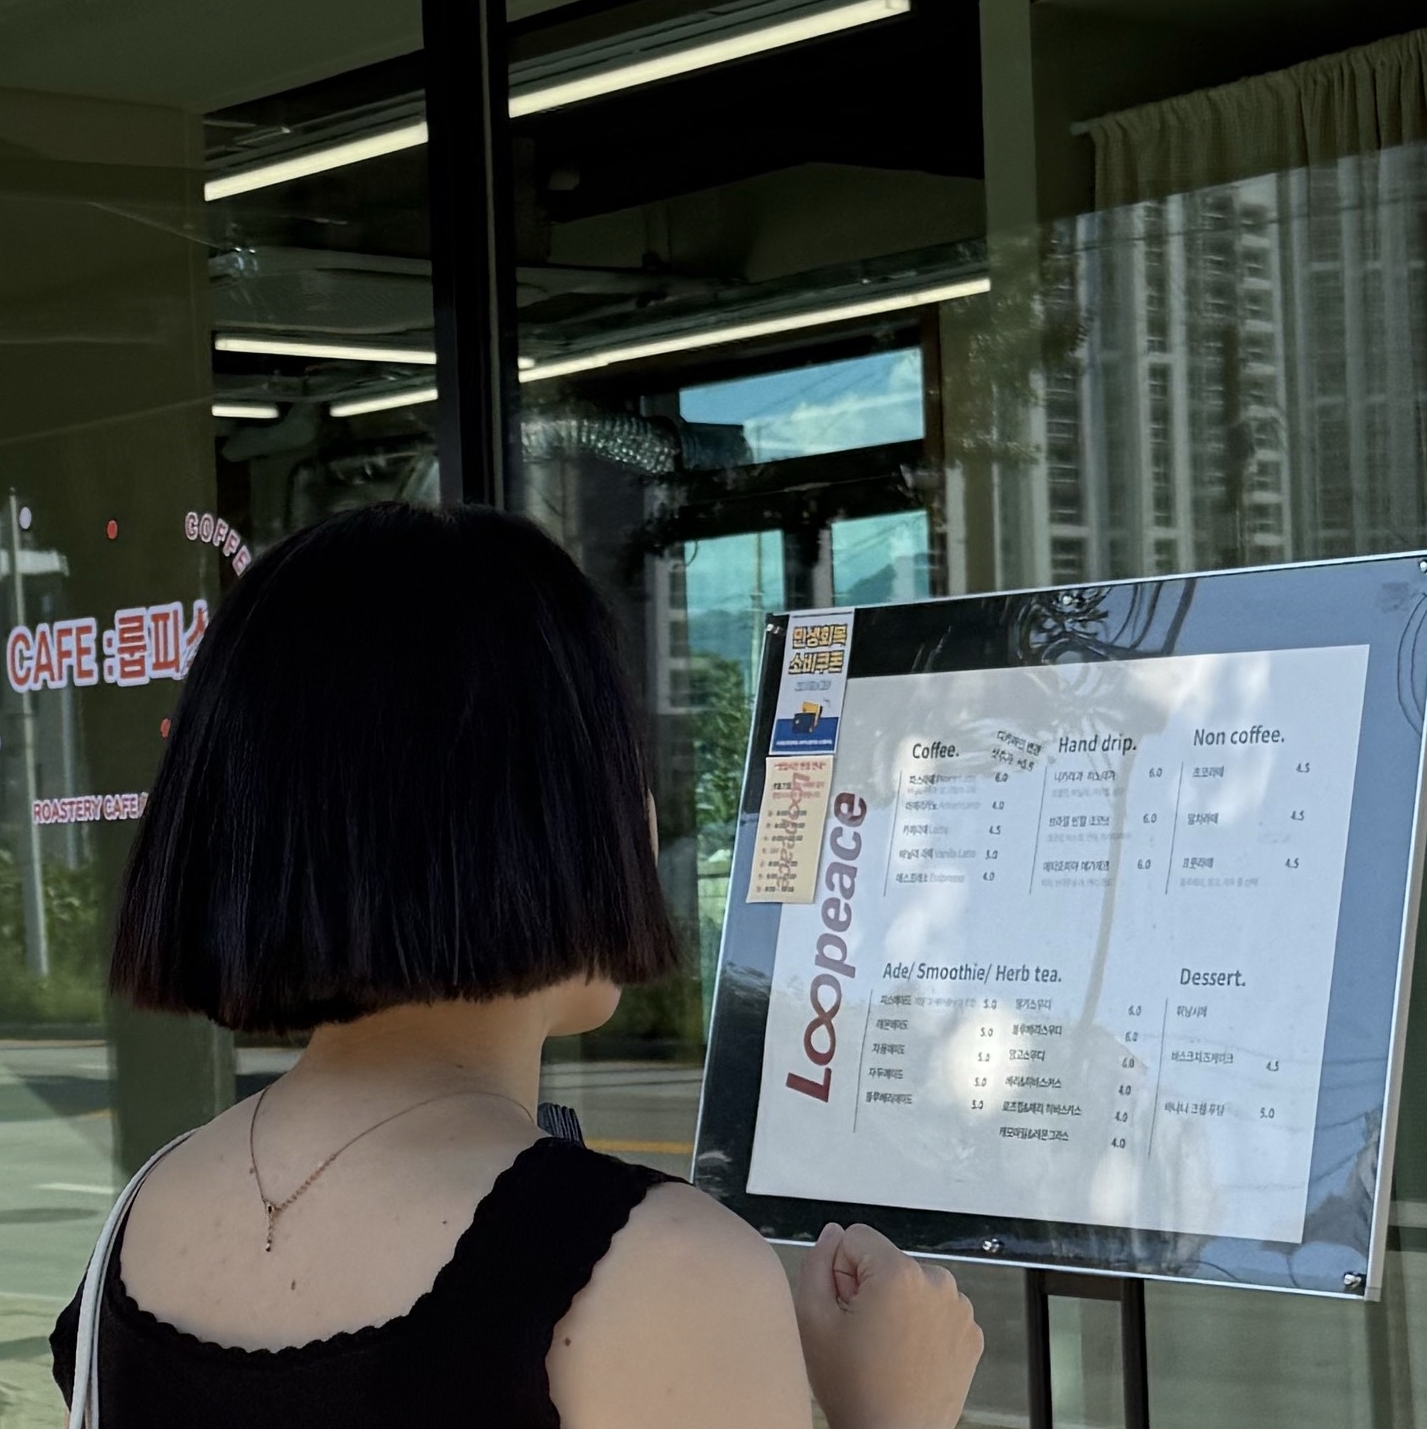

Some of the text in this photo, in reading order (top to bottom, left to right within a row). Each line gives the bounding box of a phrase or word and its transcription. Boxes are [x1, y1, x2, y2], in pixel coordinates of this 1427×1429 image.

[7, 617, 98, 693] CAFE
[1193, 725, 1285, 746] Non coffee.
[912, 741, 960, 759] Coffee.
[1058, 733, 1137, 756] Hand drip.
[1149, 767, 1163, 778] 6.0
[1296, 762, 1310, 773] 4.5
[31, 795, 102, 825] ROASTERY
[1290, 810, 1305, 821] 4.5
[1143, 813, 1157, 824] 6.0
[1137, 859, 1151, 870] 6.0
[1285, 858, 1299, 869] 4.5
[883, 961, 1062, 984] Ade/ Smoothie/ Herb tea.
[1180, 968, 1246, 987] Dessert.
[983, 999, 997, 1009] 5.0
[980, 1027, 993, 1037] 5.0
[977, 1052, 990, 1062] 5.0
[1266, 1061, 1279, 1071] 4.5
[974, 1077, 987, 1087] 5.0
[1118, 1085, 1131, 1095] 4.0
[971, 1099, 984, 1110] 5.0
[1115, 1112, 1128, 1123] 4.0
[1260, 1107, 1275, 1119] 5.0
[1111, 1137, 1126, 1149] 4.0
